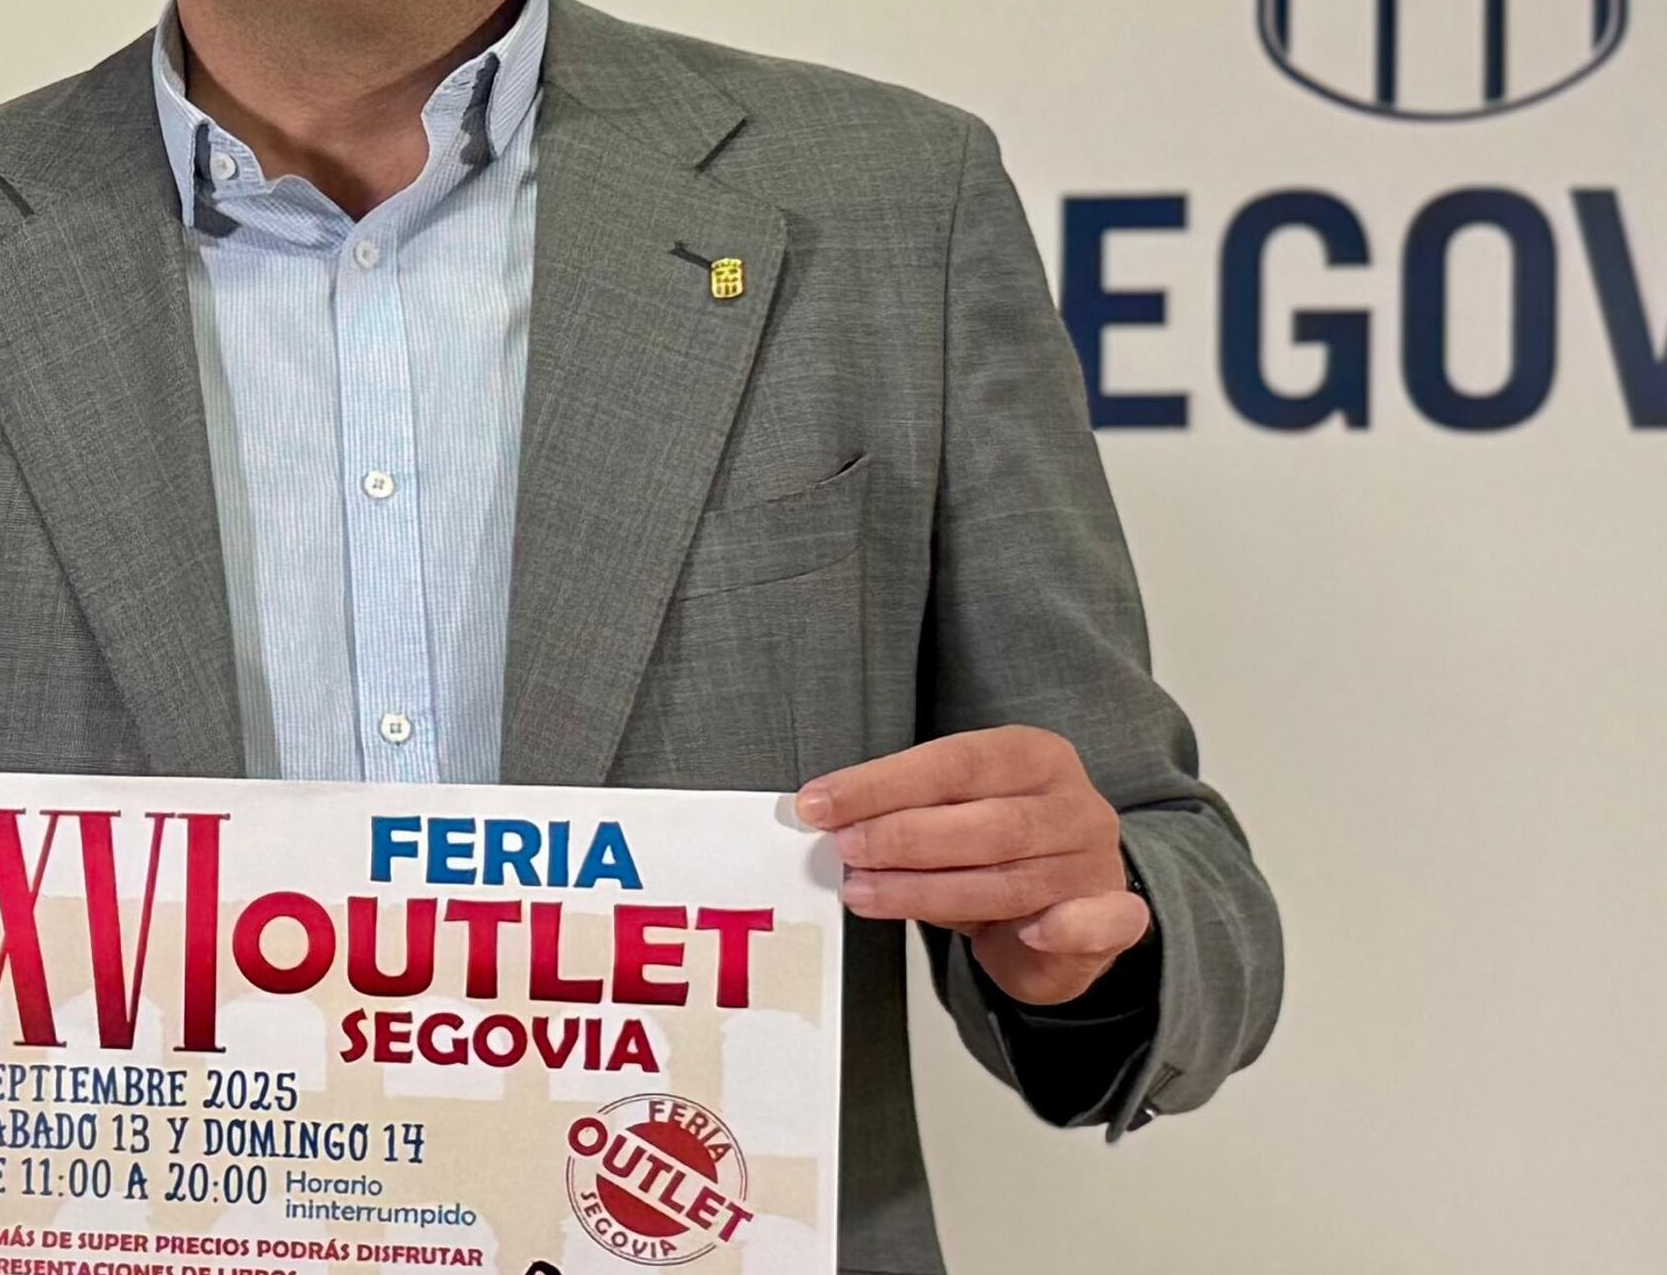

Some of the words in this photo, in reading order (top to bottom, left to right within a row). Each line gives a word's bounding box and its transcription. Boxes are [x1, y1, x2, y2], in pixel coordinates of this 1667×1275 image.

[1059, 186, 1667, 433] EGOV
[370, 815, 643, 890] FERIA
[232, 891, 774, 1009] OUTLET
[339, 1007, 660, 1073] SEGOVIA
[202, 1069, 298, 1112] 2025
[111, 1113, 150, 1154] 13
[166, 1116, 189, 1154] Y
[202, 1118, 369, 1162] DOMINGO
[382, 1122, 425, 1164] 14
[647, 1100, 734, 1162] FERIA
[21, 1157, 111, 1199] 11:00
[123, 1161, 149, 1200] A
[164, 1161, 267, 1205] 20:00
[285, 1169, 383, 1196] Horario
[565, 1116, 754, 1243] OUTLET
[40, 1230, 72, 1249] DE
[77, 1232, 149, 1253] SUPER
[155, 1235, 249, 1256] PRECIOS
[256, 1237, 350, 1261] PODRÁS
[356, 1243, 483, 1267] DISFRUTAR
[579, 1191, 679, 1259] SEGOVIA
